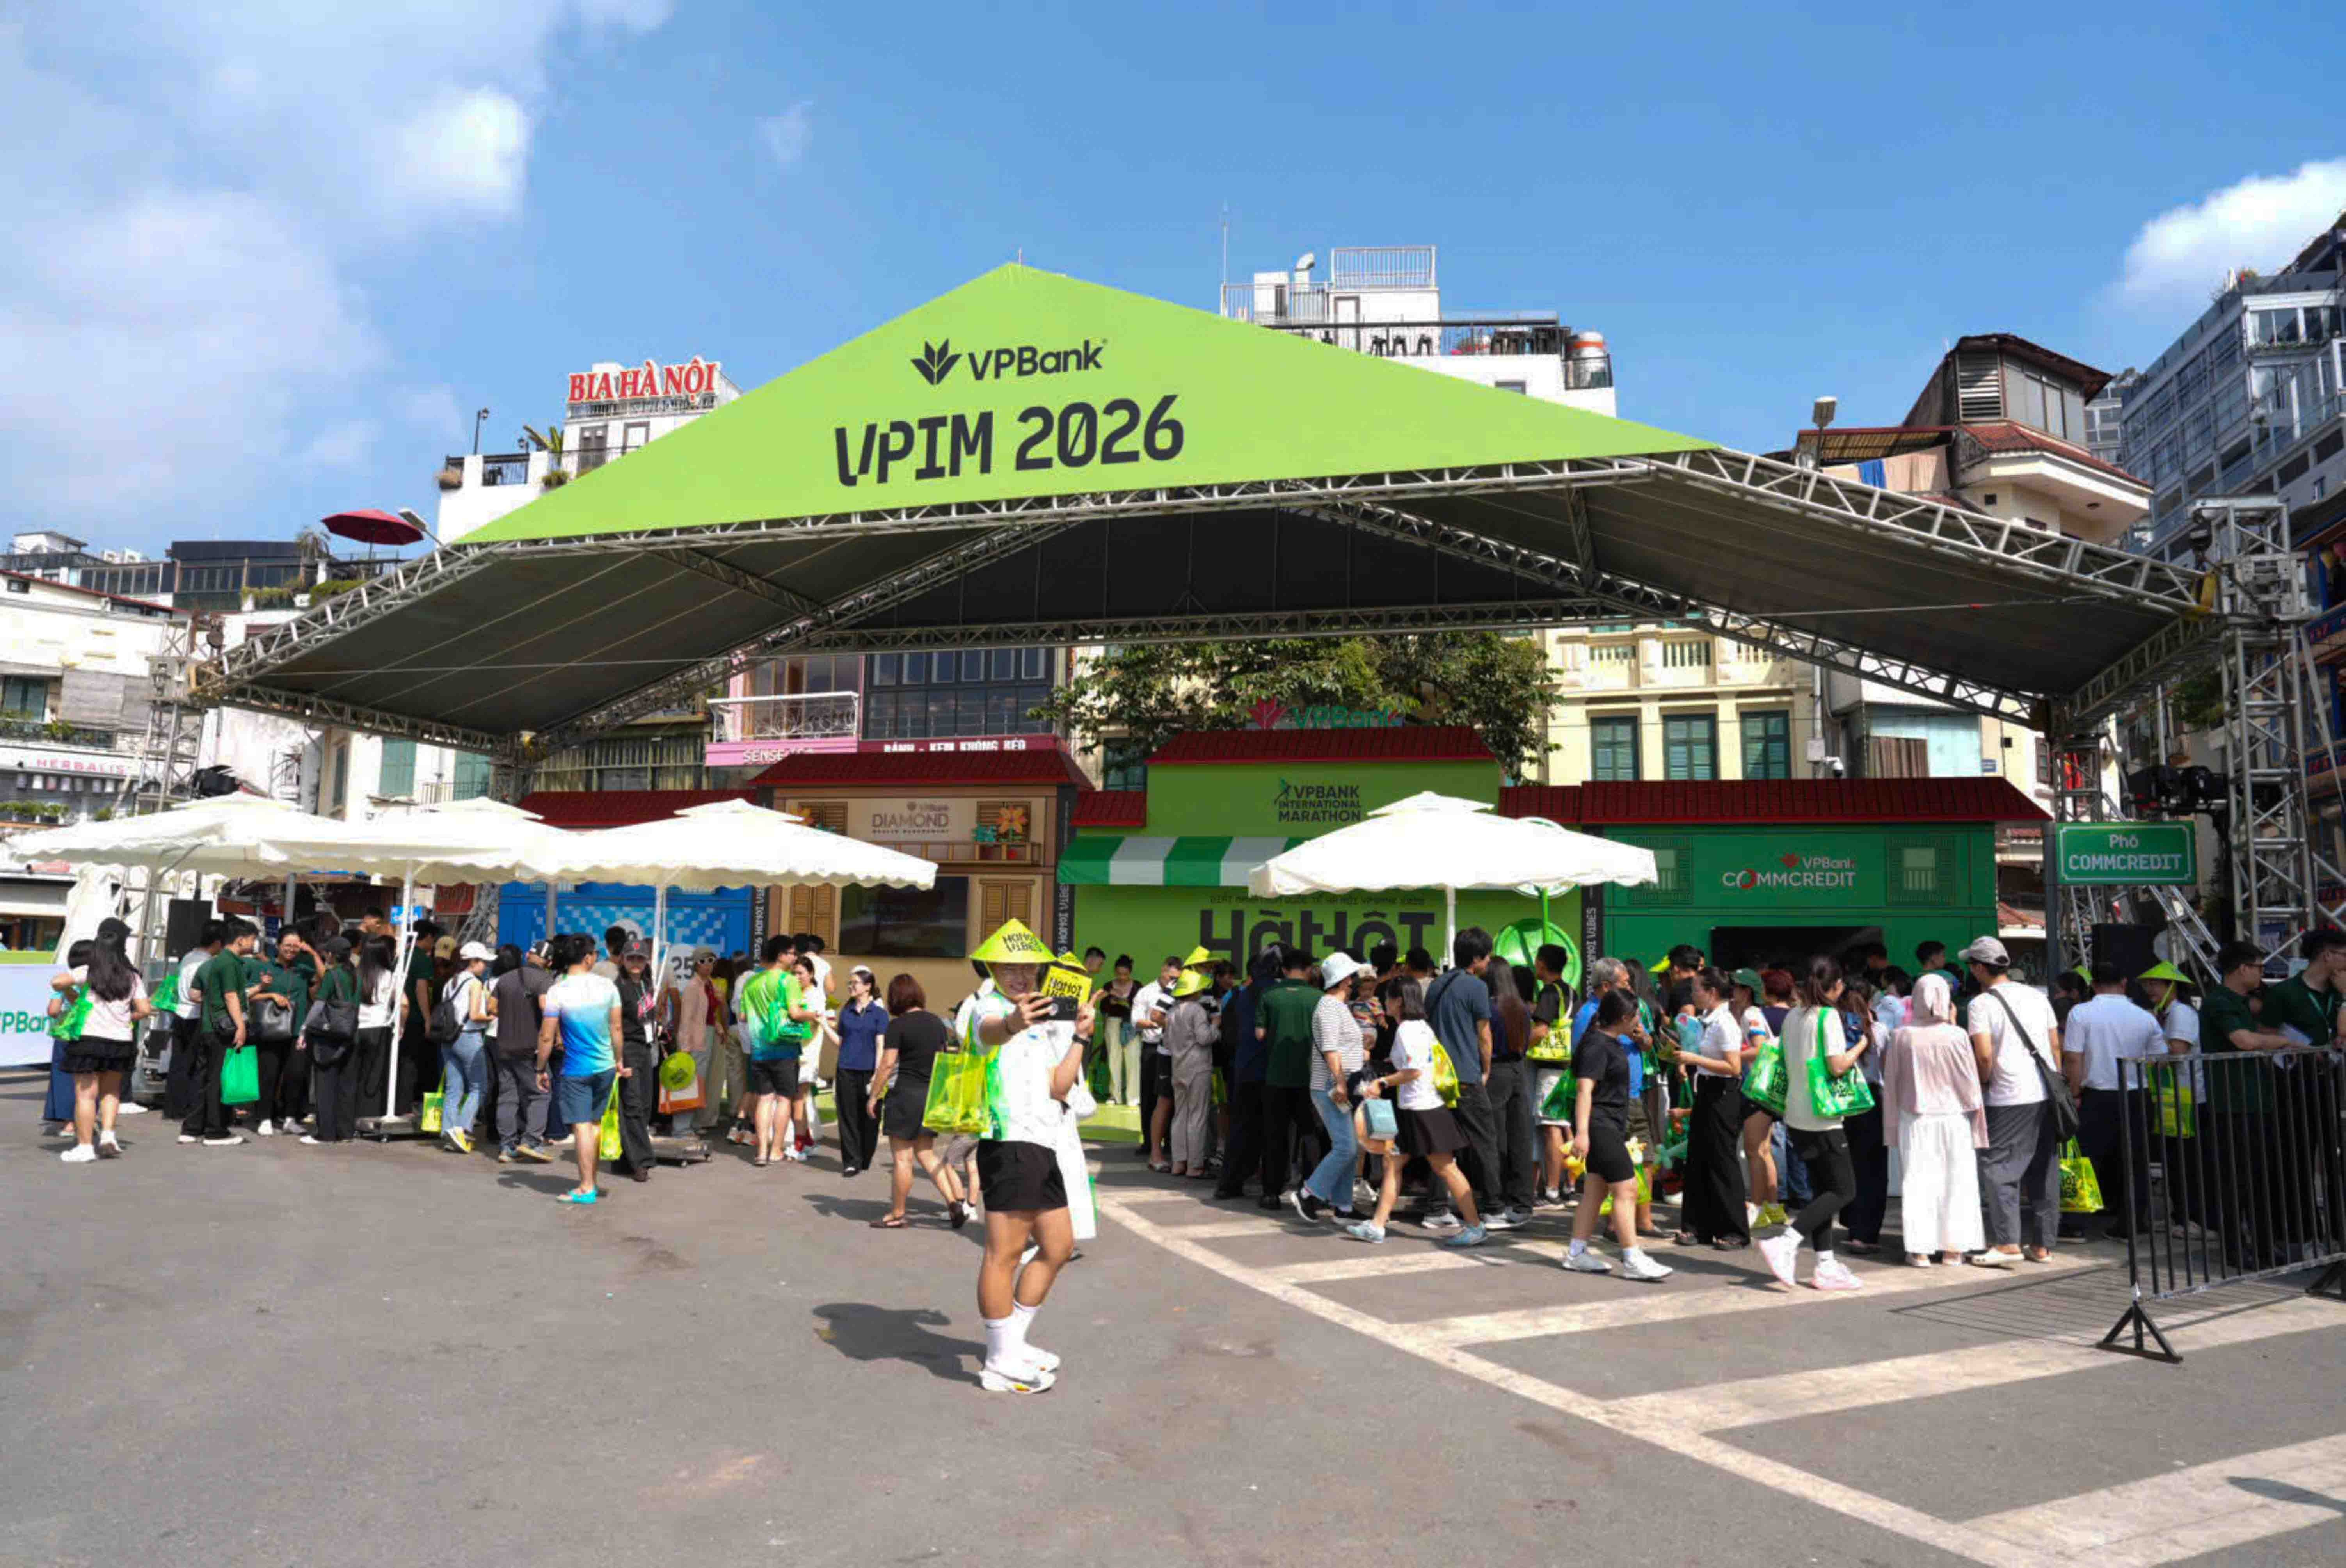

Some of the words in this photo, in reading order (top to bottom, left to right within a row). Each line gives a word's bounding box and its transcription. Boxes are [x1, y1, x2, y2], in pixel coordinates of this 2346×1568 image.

[968, 340, 1104, 381] VPBank
[568, 372, 613, 402] BIA
[618, 359, 659, 398] HÀ
[663, 357, 717, 403] NỘI
[835, 411, 994, 487] VPIM
[1015, 394, 1184, 471] 2026
[1292, 704, 1401, 728] VPBank
[1293, 785, 1360, 799] VPBANK
[1279, 800, 1361, 808] INTERNATIONAL
[872, 812, 949, 828] DIAMOND
[1279, 809, 1361, 822] MARATHON
[1802, 856, 1855, 868] VPBank
[2069, 854, 2182, 871] COMMCREDIT
[1722, 868, 1857, 889] COMMCREDIT
[0, 1010, 51, 1035] PBan
